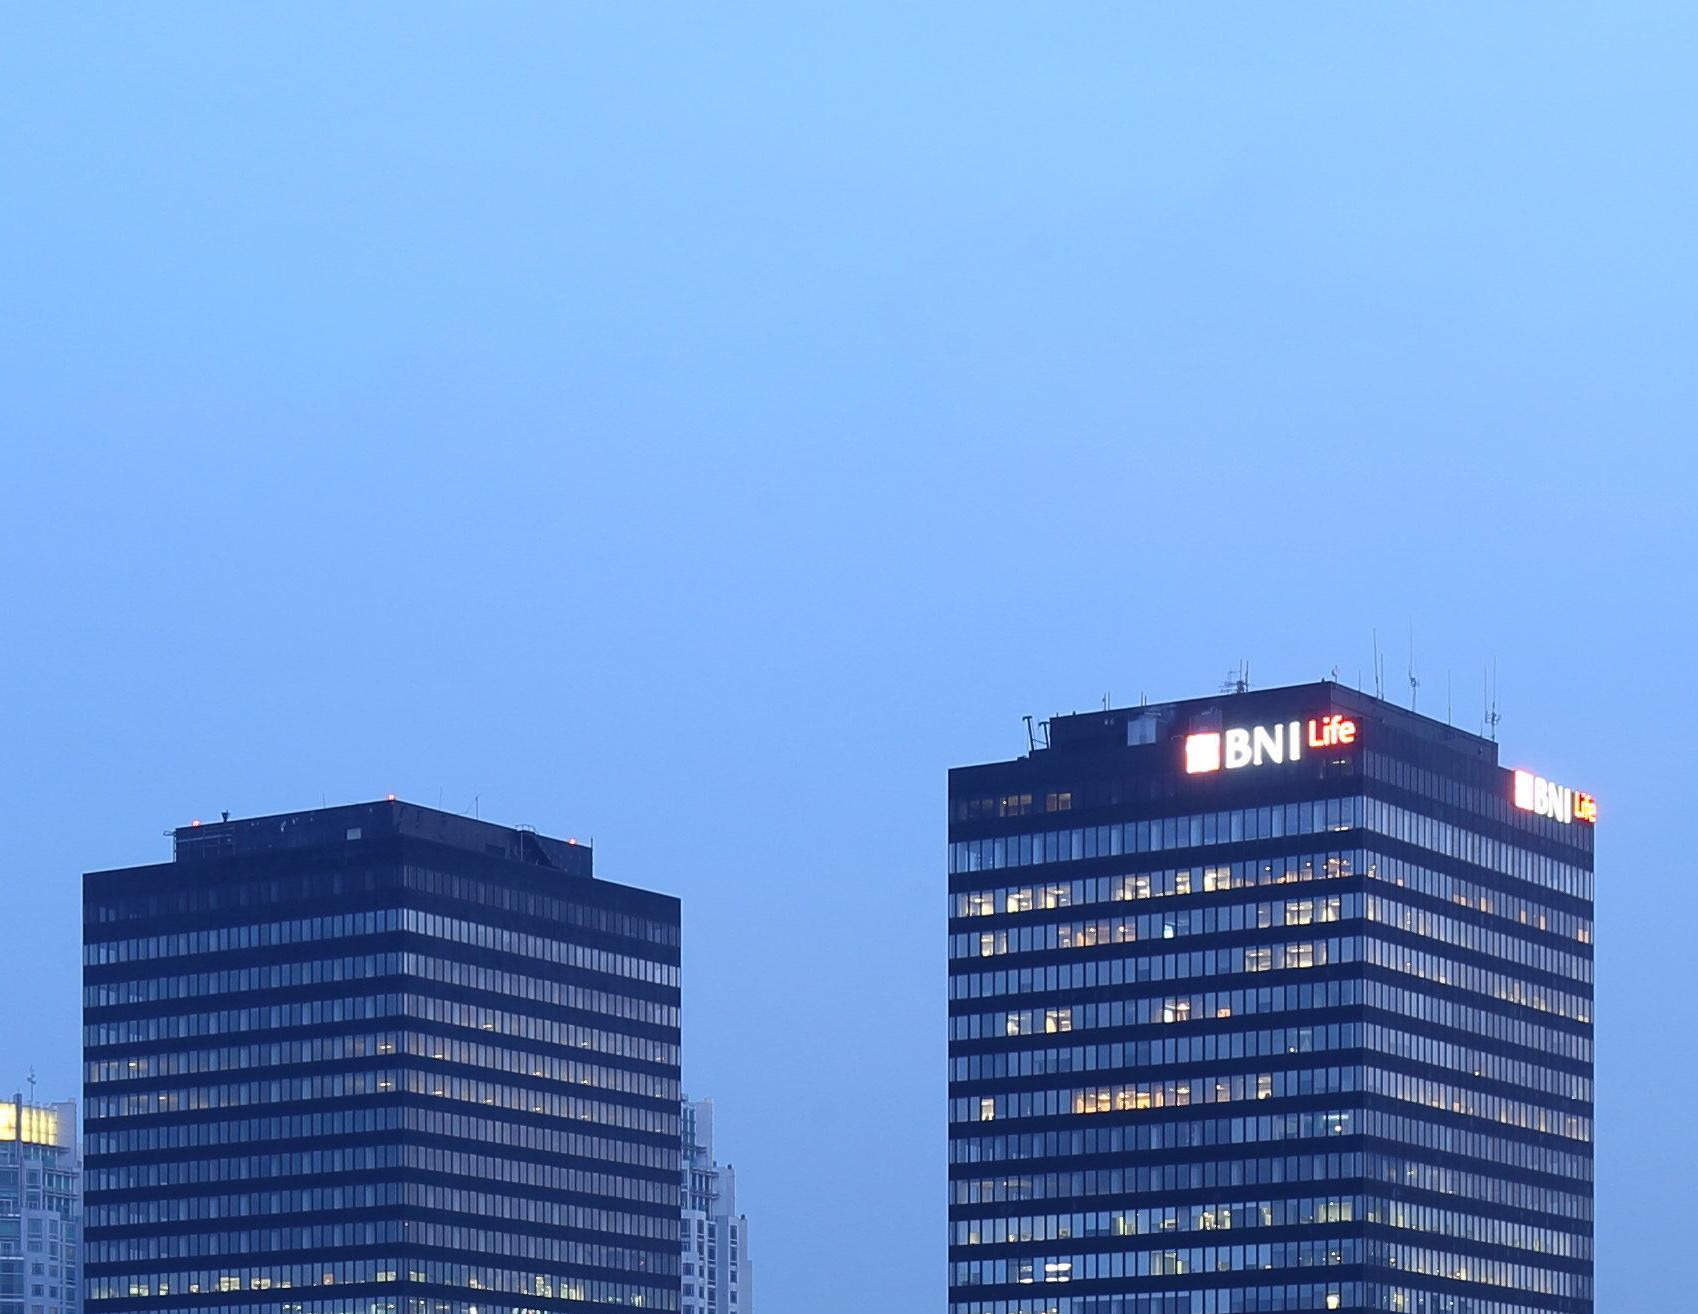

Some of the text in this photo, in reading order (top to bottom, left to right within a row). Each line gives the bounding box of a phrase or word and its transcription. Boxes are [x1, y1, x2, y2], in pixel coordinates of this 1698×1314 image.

[1224, 714, 1357, 769] BNI Life
[1534, 776, 1571, 824] BNI
